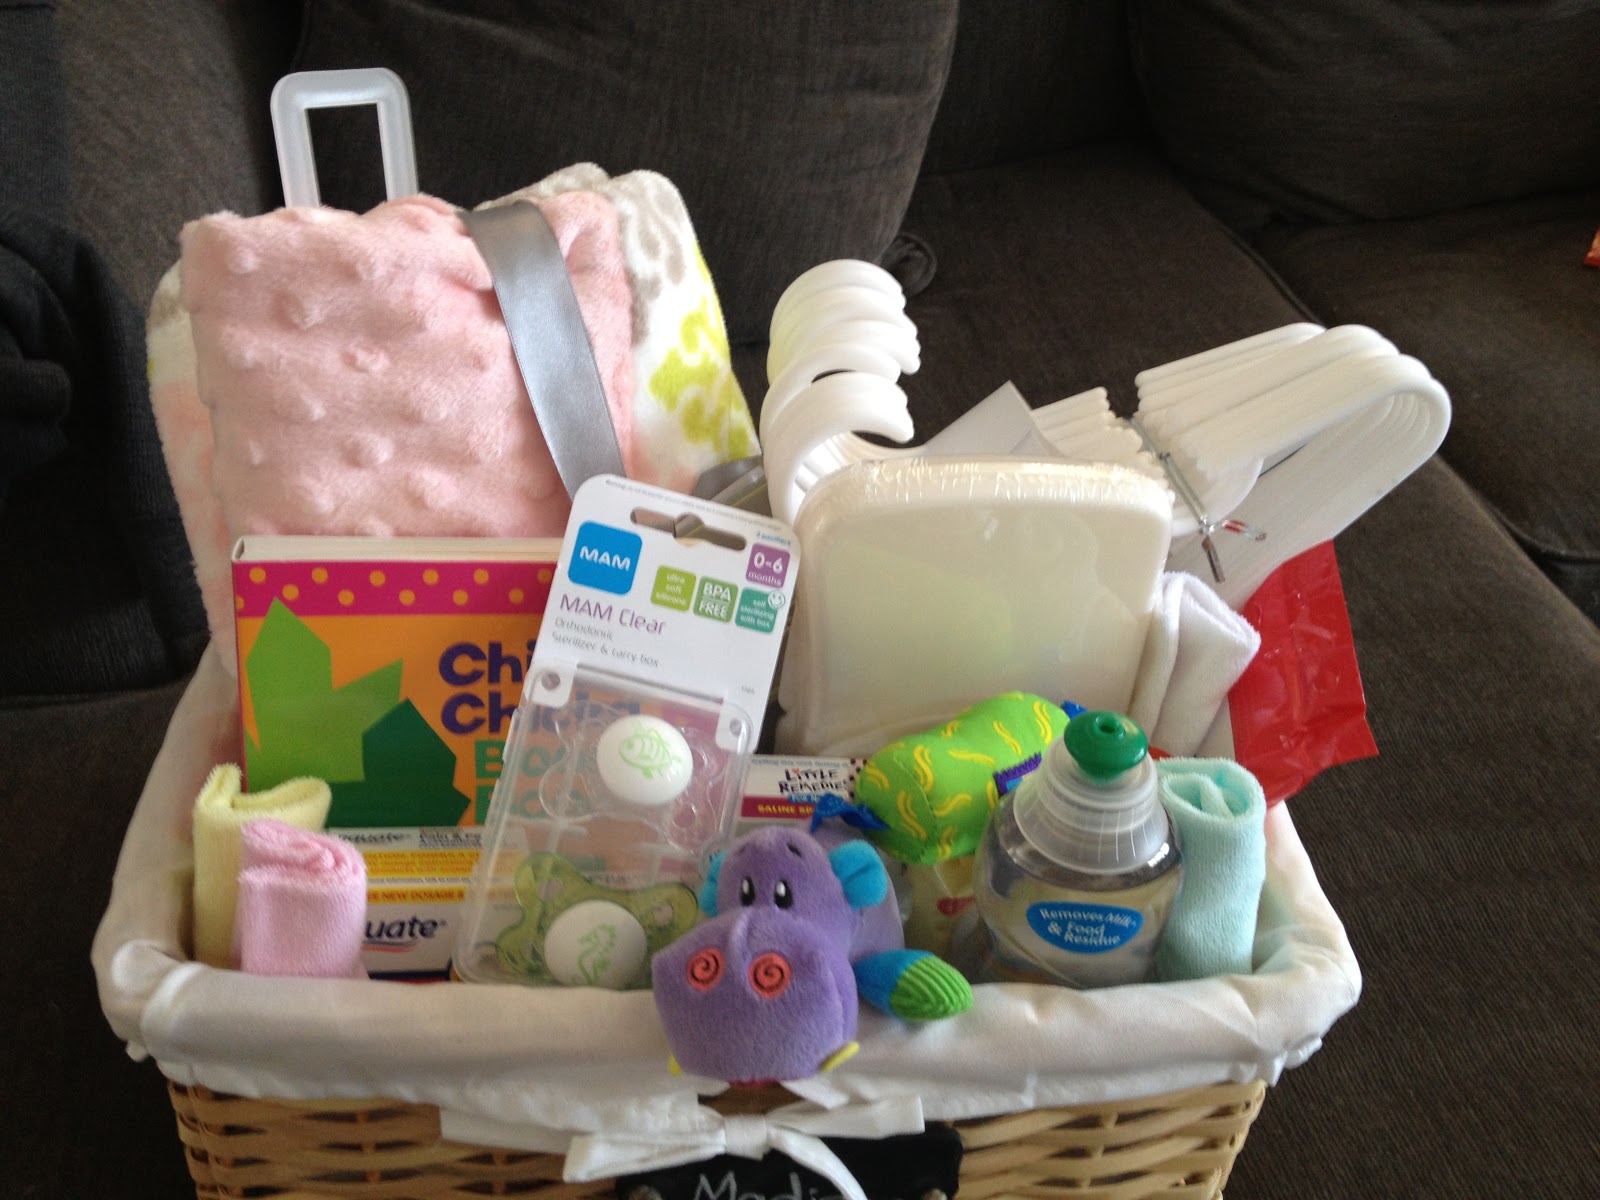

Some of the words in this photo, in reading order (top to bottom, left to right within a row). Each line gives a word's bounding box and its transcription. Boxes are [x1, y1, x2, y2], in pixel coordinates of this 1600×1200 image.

[579, 545, 631, 571] MAM
[753, 551, 783, 574] 0-6
[748, 572, 782, 587] months
[702, 582, 732, 602] BPA
[560, 593, 613, 622] MAM
[619, 608, 667, 635] Clear
[698, 599, 730, 619] FREE
[552, 631, 597, 651] Sterilizer
[600, 644, 609, 656] &
[612, 648, 638, 663] carry
[640, 654, 659, 668] box
[438, 641, 537, 686] Chi
[1040, 908, 1104, 922] Removes
[365, 913, 439, 939] uate
[1047, 921, 1063, 937] &
[1066, 920, 1105, 937] Food
[1064, 931, 1122, 946] Residue
